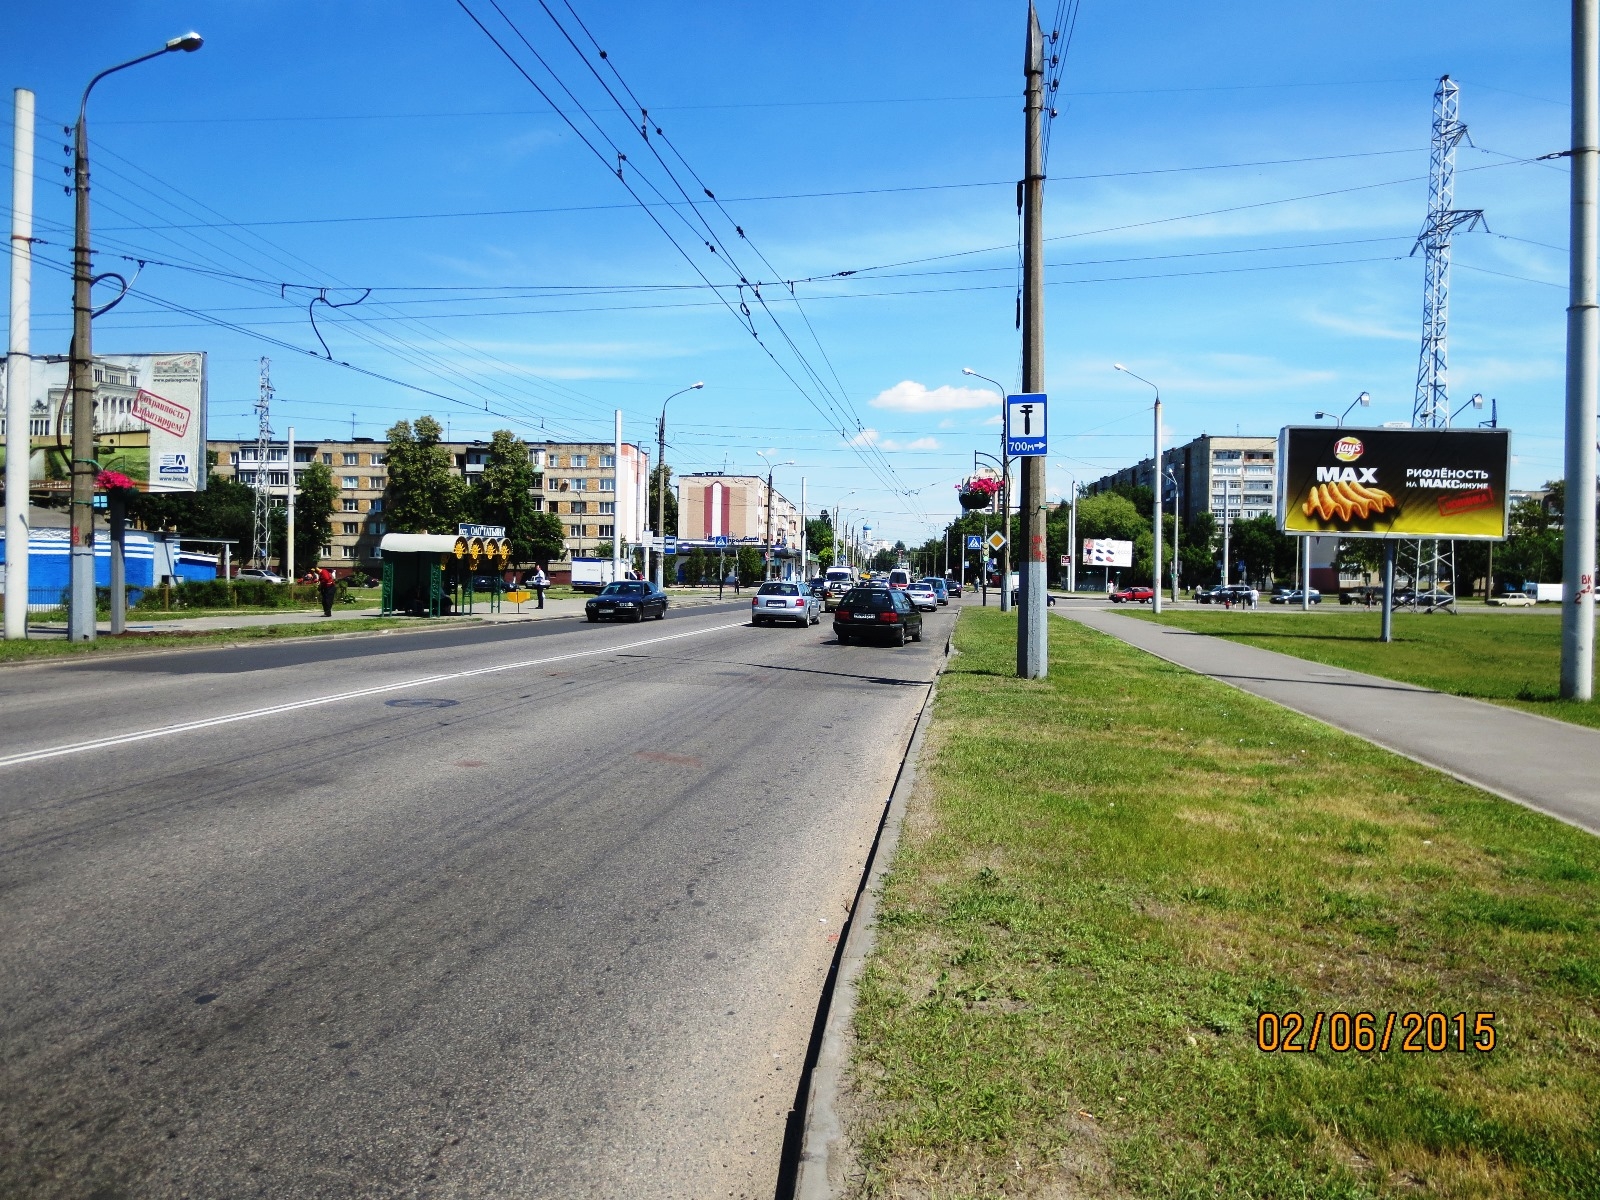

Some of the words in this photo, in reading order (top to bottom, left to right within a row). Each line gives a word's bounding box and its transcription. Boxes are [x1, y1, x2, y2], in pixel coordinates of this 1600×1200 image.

[1008, 441, 1035, 452] 700м
[1336, 441, 1361, 456] Lay's
[1316, 466, 1378, 484] MAX
[1406, 468, 1489, 479] РИФЛЁНОСТЬ
